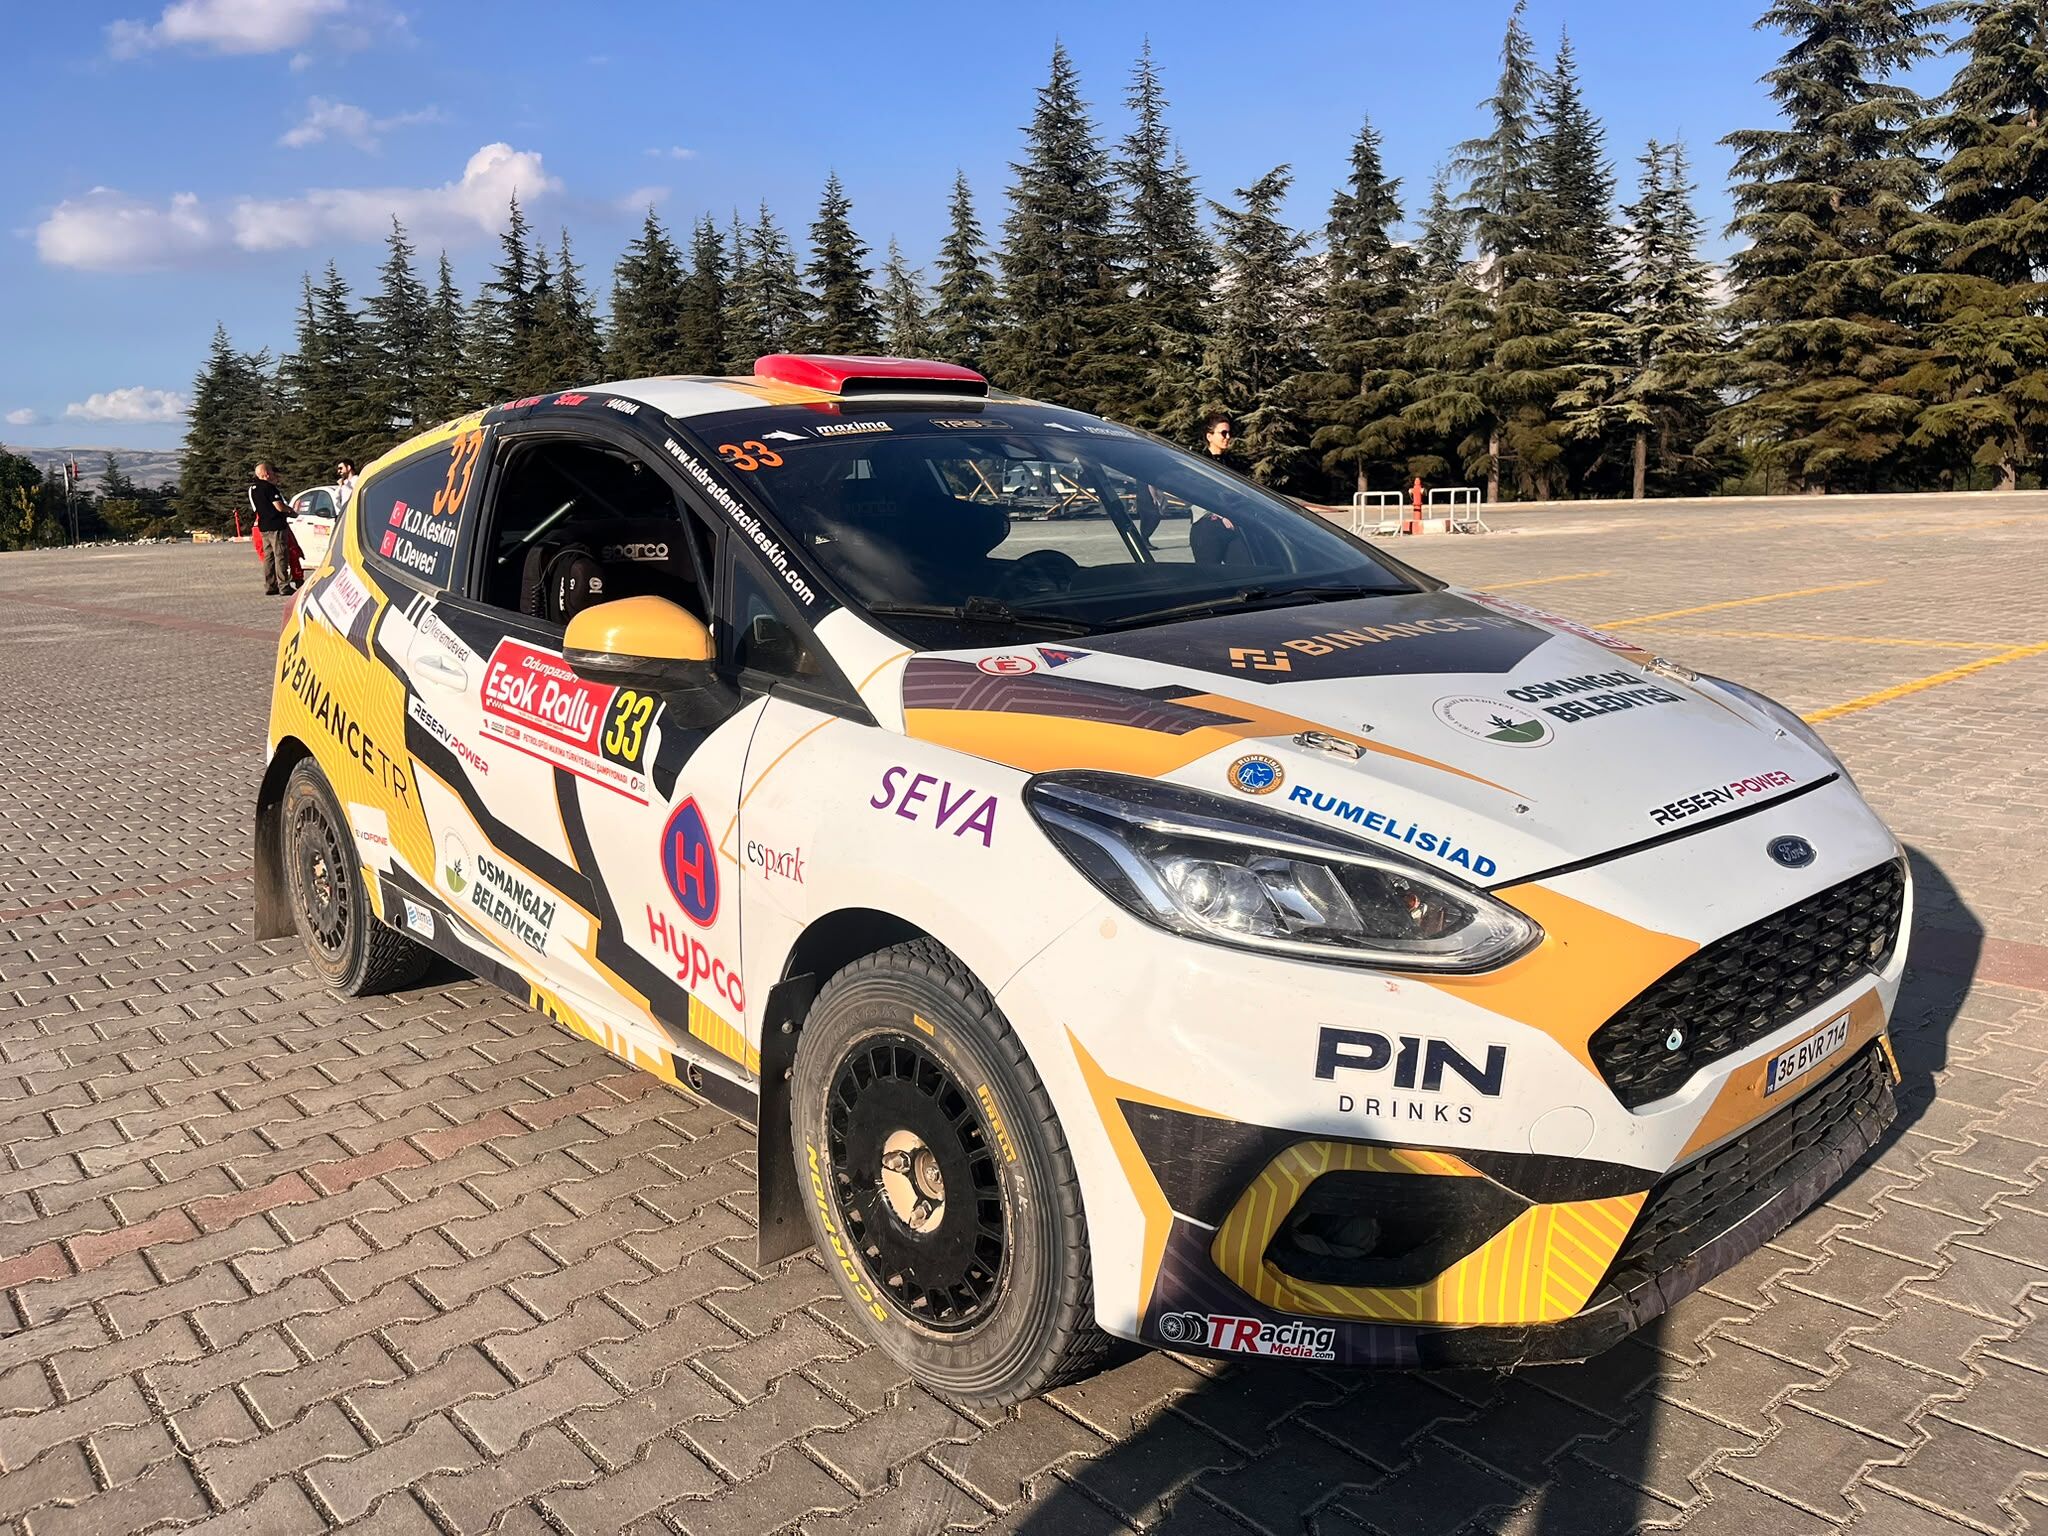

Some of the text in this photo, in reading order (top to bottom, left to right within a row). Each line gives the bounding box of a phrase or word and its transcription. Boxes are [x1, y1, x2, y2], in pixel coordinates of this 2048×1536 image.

[433, 430, 482, 516] 33
[718, 441, 784, 471] 33
[392, 537, 438, 575] K.Deveci
[401, 507, 456, 548] K.D.Keskin
[664, 437, 816, 606] www.kubradenizcikeskin.com
[486, 662, 599, 738] Esok Rally
[1506, 670, 1648, 702] OSMANGAZİ
[1541, 685, 1687, 723] BELEDİYESİ
[606, 690, 654, 762] 33
[870, 766, 998, 848] SEVA
[1288, 785, 1497, 878] RUMELİSİAD
[478, 854, 556, 930] OSMANGAZİ
[646, 903, 745, 1013] Hypco
[1314, 1026, 1507, 1097] PIN
[1798, 1036, 1824, 1069] BVR
[1826, 1022, 1846, 1051] 714
[1339, 1095, 1473, 1124] DRINKS
[806, 1143, 888, 1322] SCORPION
